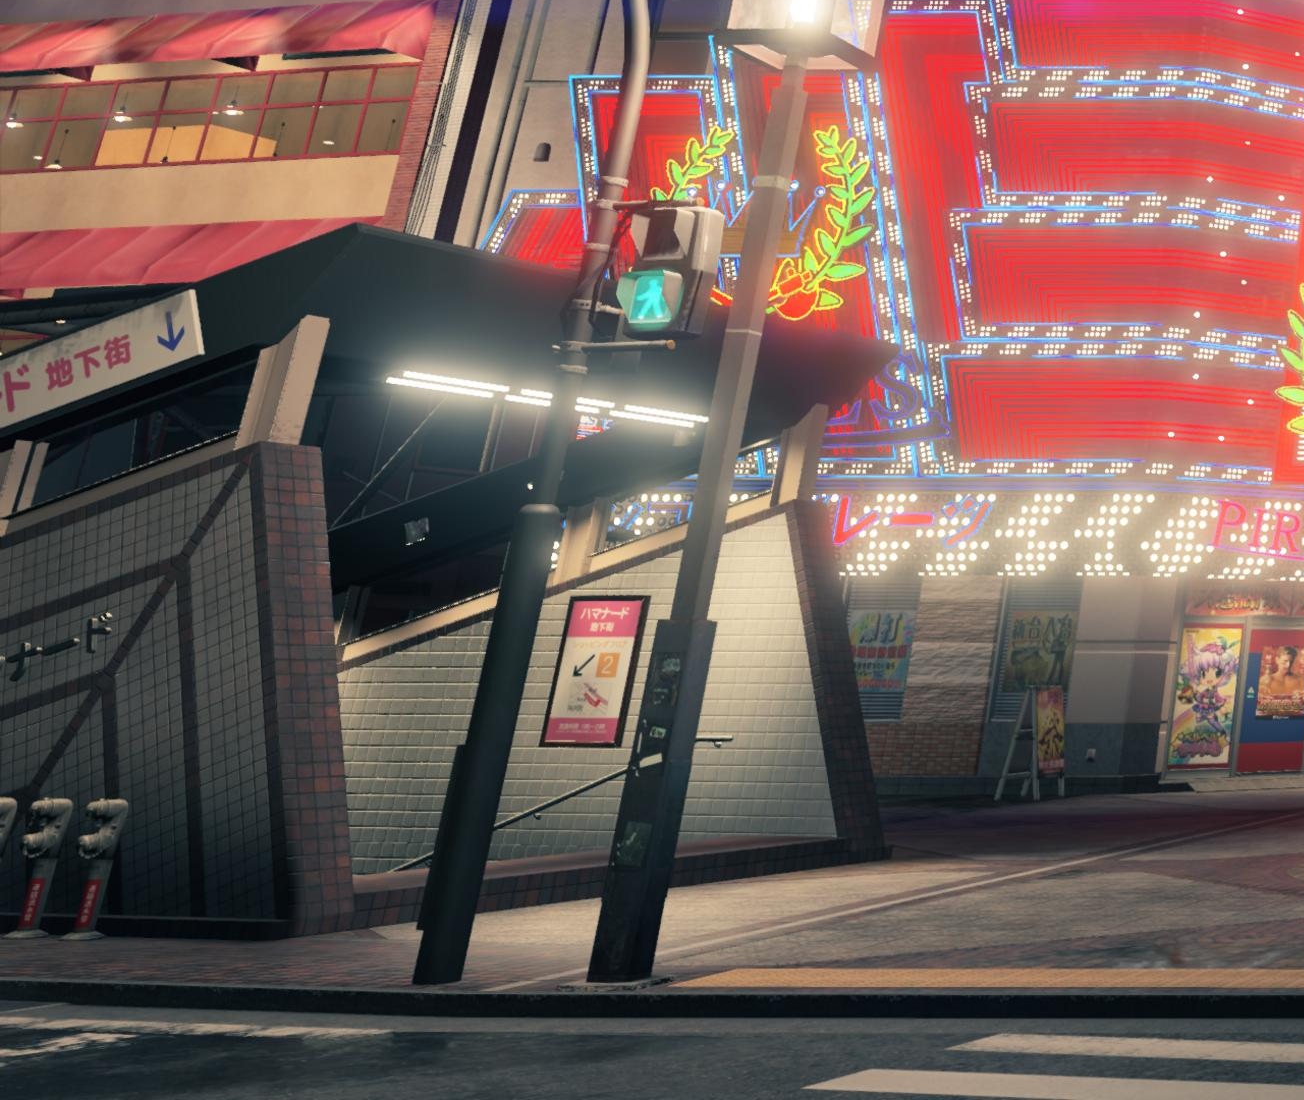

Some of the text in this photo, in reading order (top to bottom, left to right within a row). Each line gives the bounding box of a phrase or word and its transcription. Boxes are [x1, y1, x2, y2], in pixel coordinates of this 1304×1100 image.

[0, 334, 132, 413] ド 地下街
[580, 606, 630, 620] ハマナード
[601, 655, 614, 675] 2
